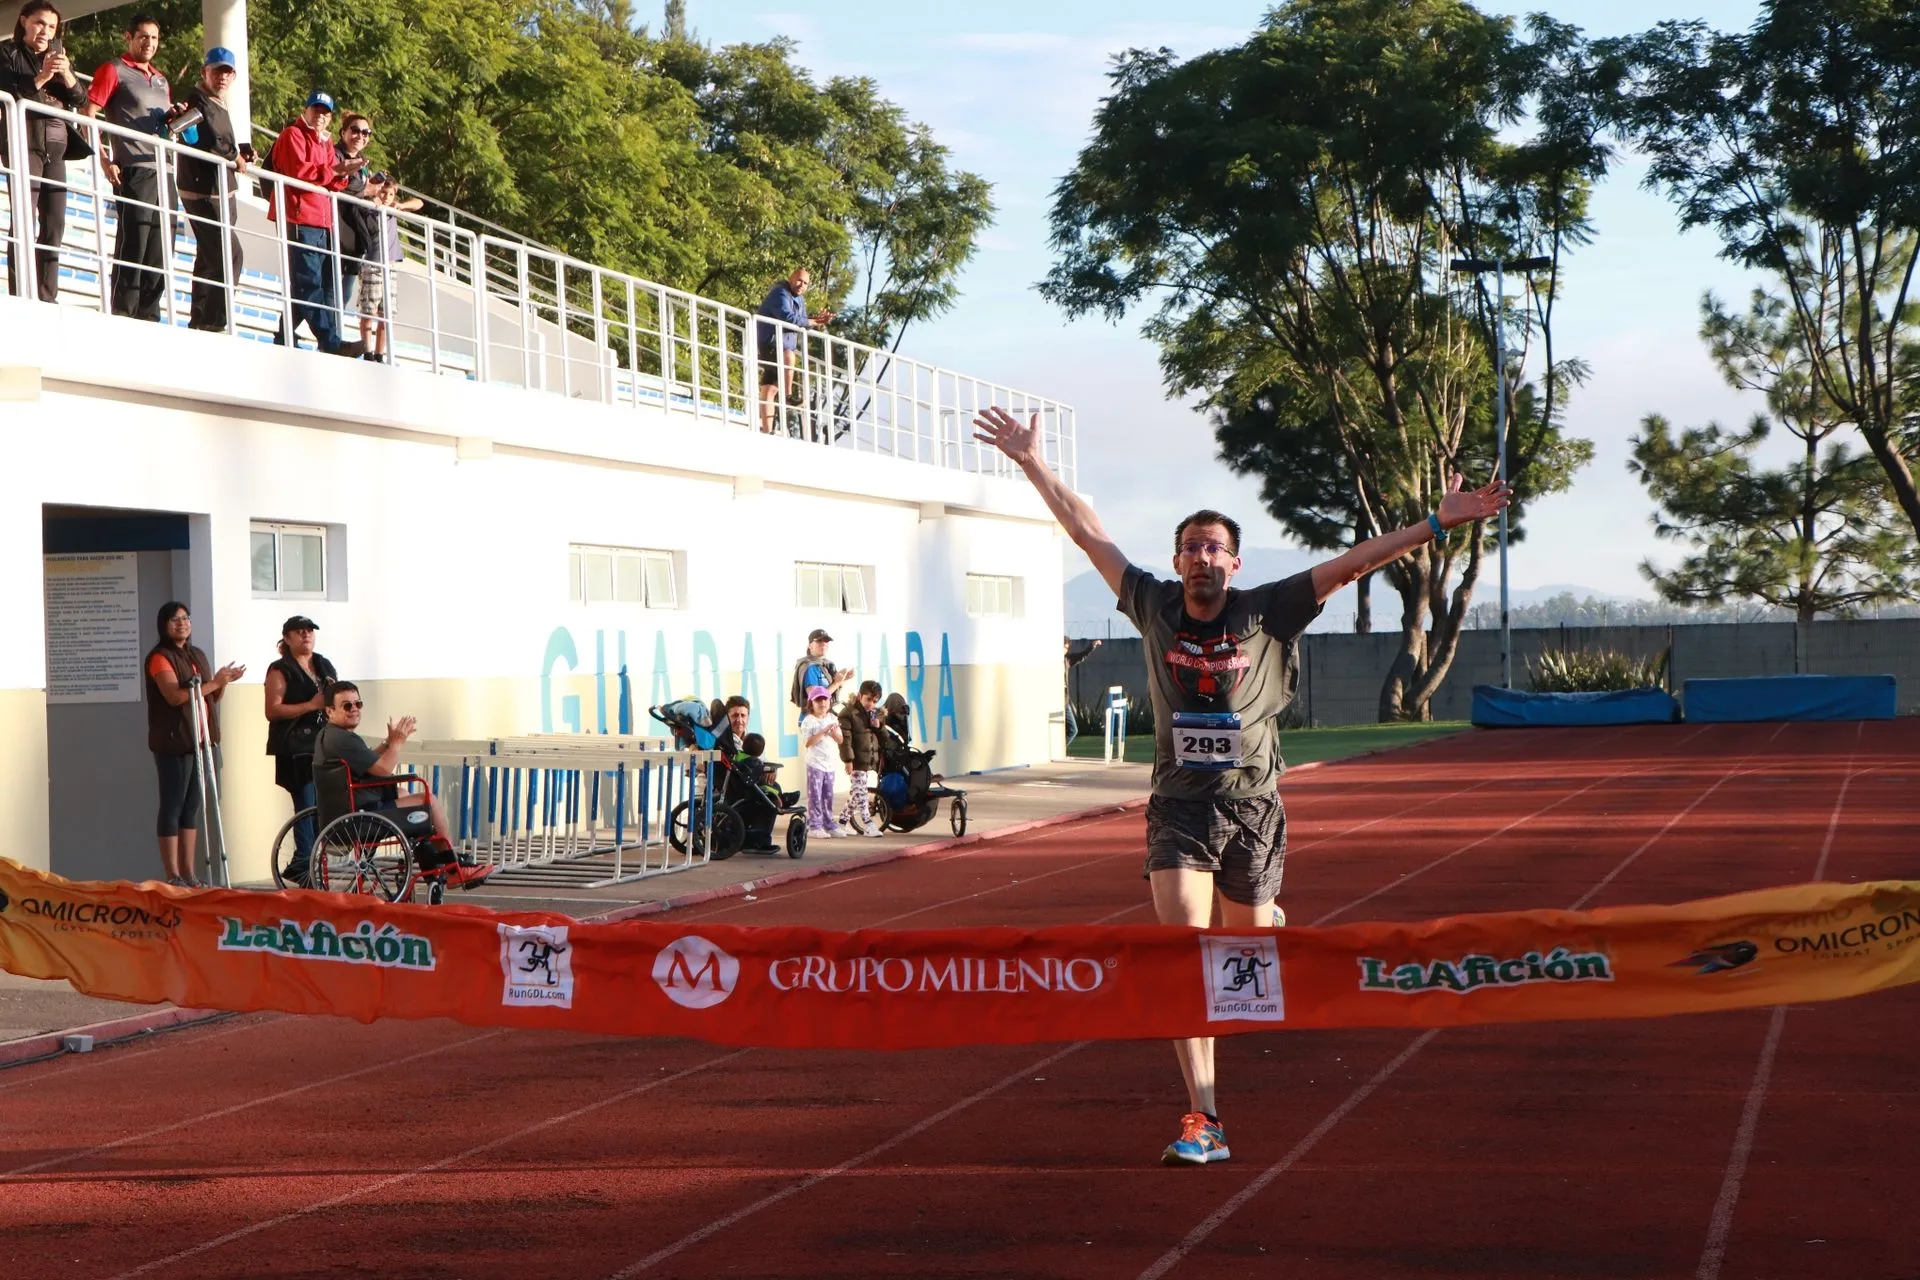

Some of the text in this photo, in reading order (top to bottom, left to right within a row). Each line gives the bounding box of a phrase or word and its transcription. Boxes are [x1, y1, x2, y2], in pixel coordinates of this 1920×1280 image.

[540, 626, 958, 758] GUADALARA
[1182, 736, 1232, 754] 293
[769, 955, 914, 993] GRUPO
[1360, 948, 1611, 991] LaAfición
[508, 988, 566, 1000] RunGDL.com
[1213, 1002, 1278, 1014] RunGDL.com
